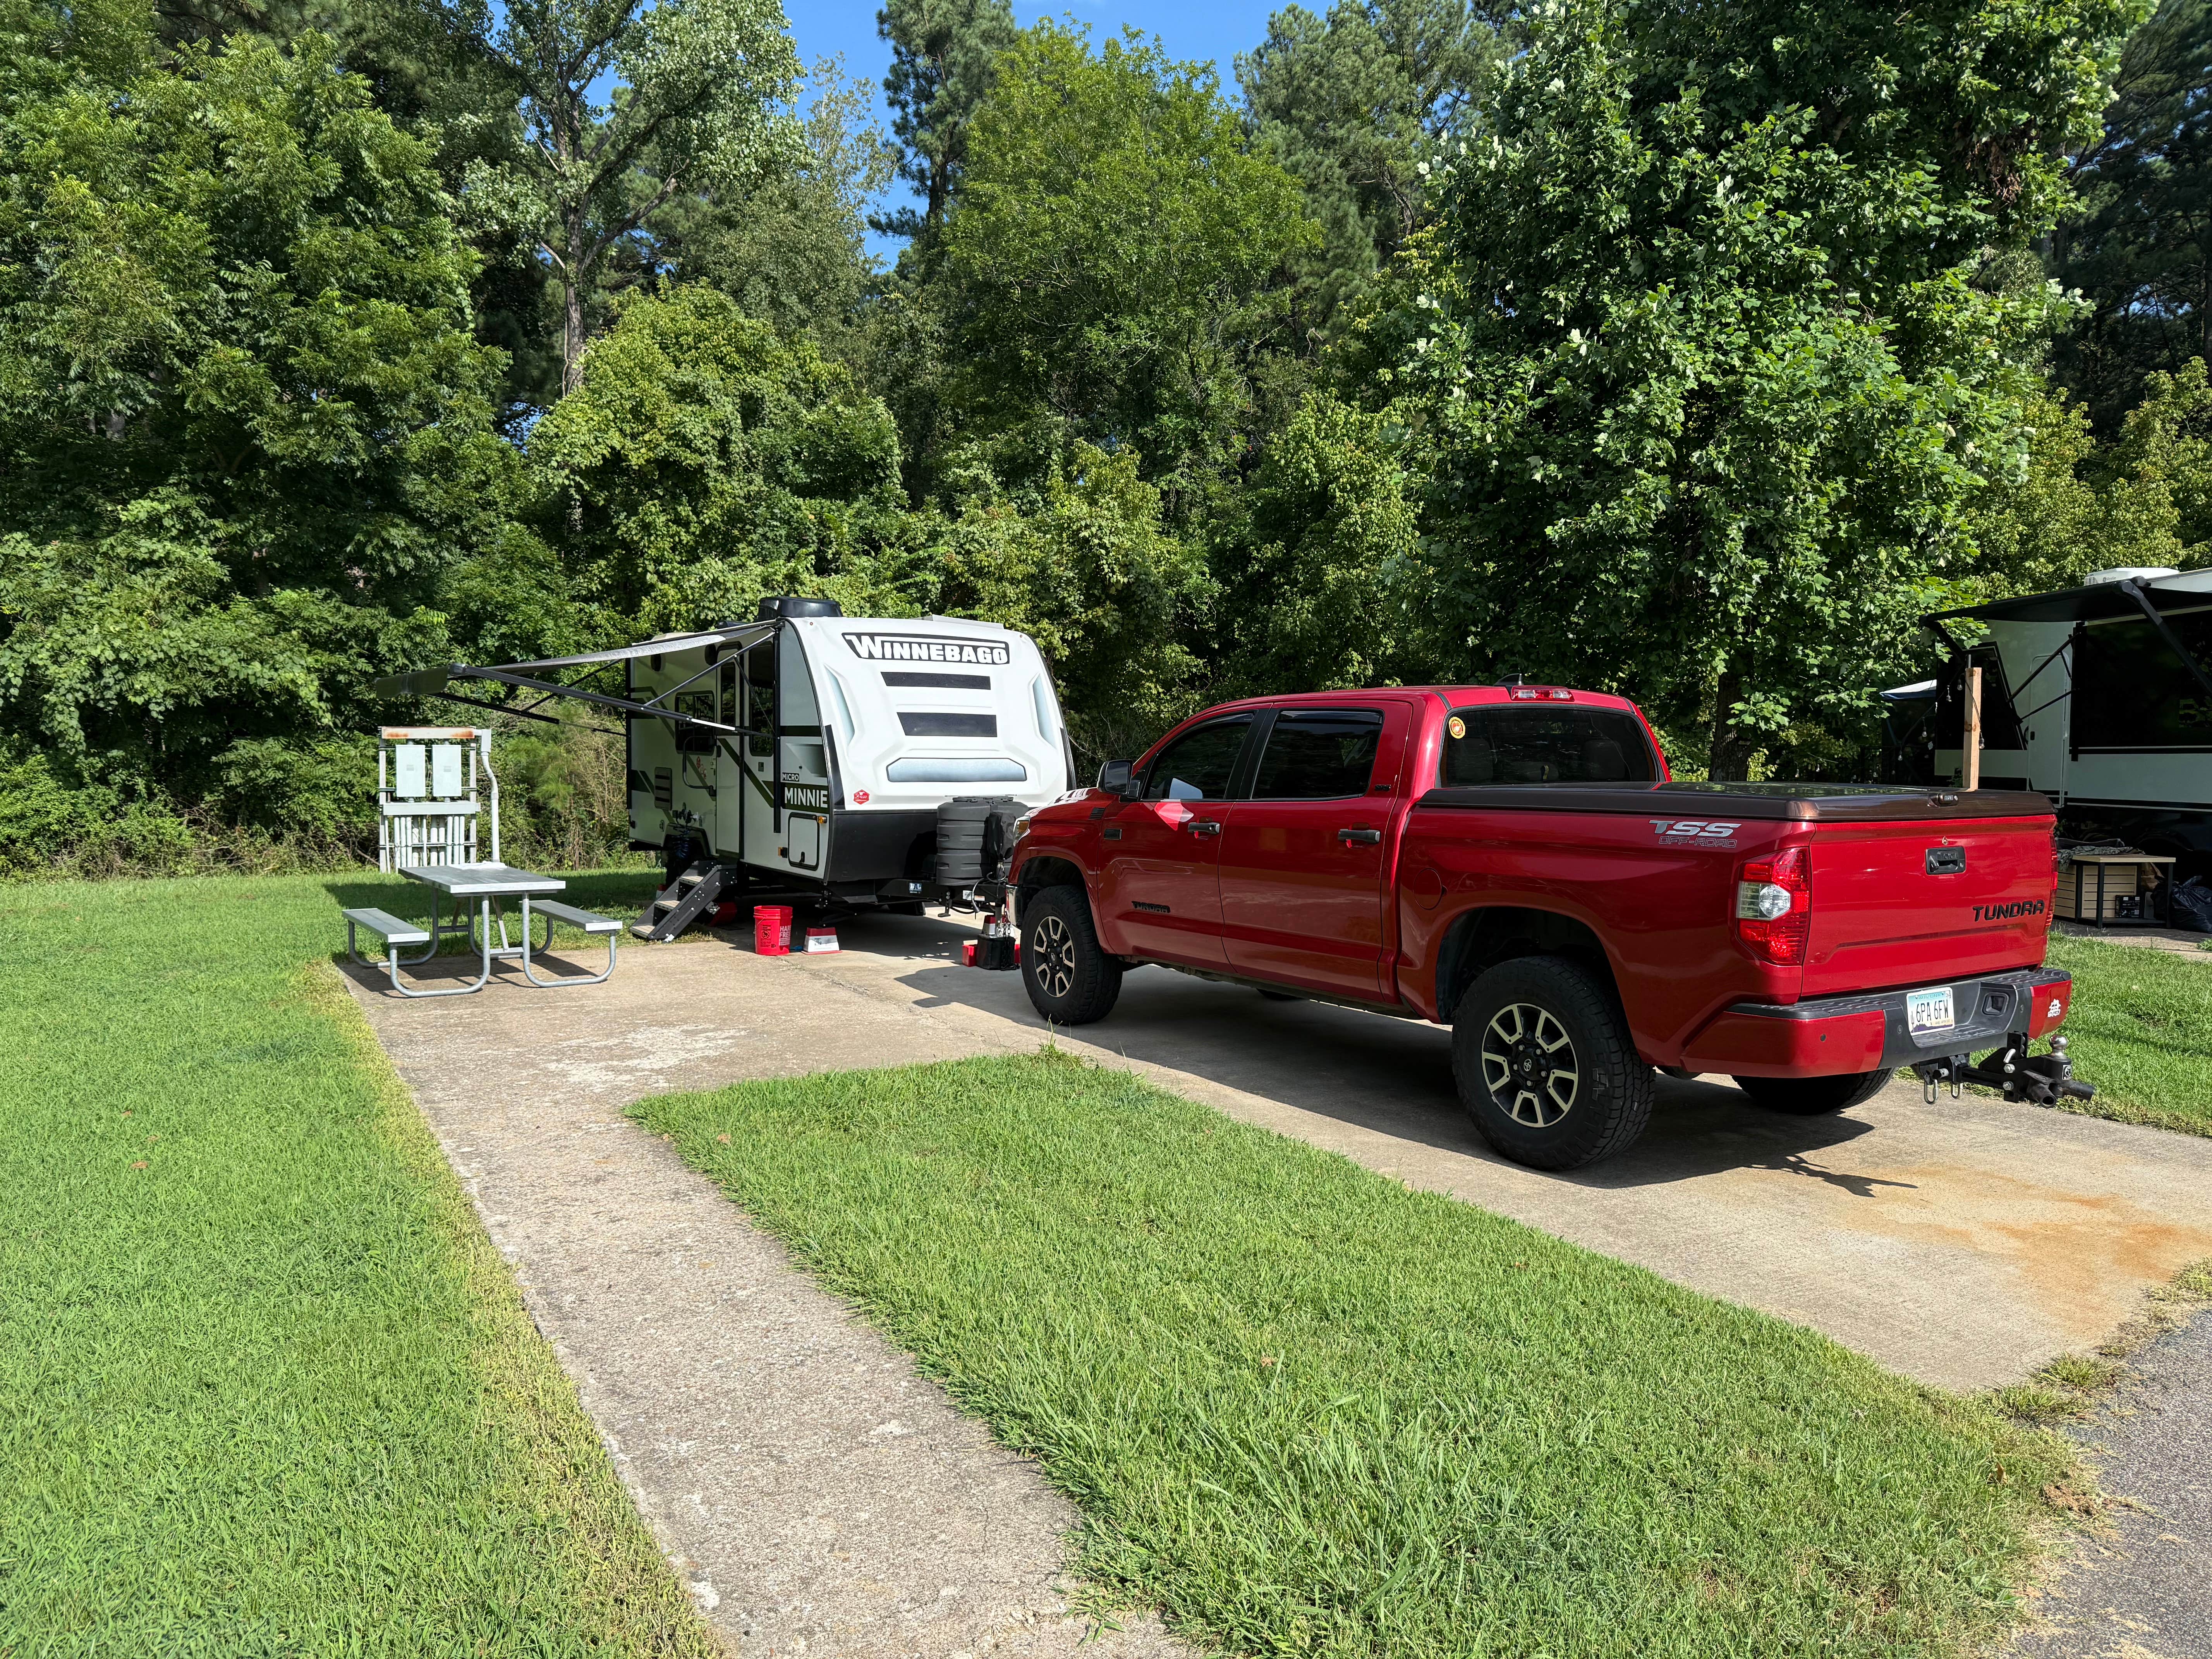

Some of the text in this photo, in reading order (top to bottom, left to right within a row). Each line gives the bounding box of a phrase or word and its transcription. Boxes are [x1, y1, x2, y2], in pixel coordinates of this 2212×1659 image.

[844, 635, 1008, 664] WINNEBAGO
[782, 773, 799, 781] MICRO
[785, 787, 828, 808] MINNIE
[1649, 820, 1742, 837] TSS
[1658, 836, 1737, 848] OFF-ROAD
[1972, 899, 2045, 922] TUNDRA
[1916, 999, 1948, 1022] 6PA 6FW
